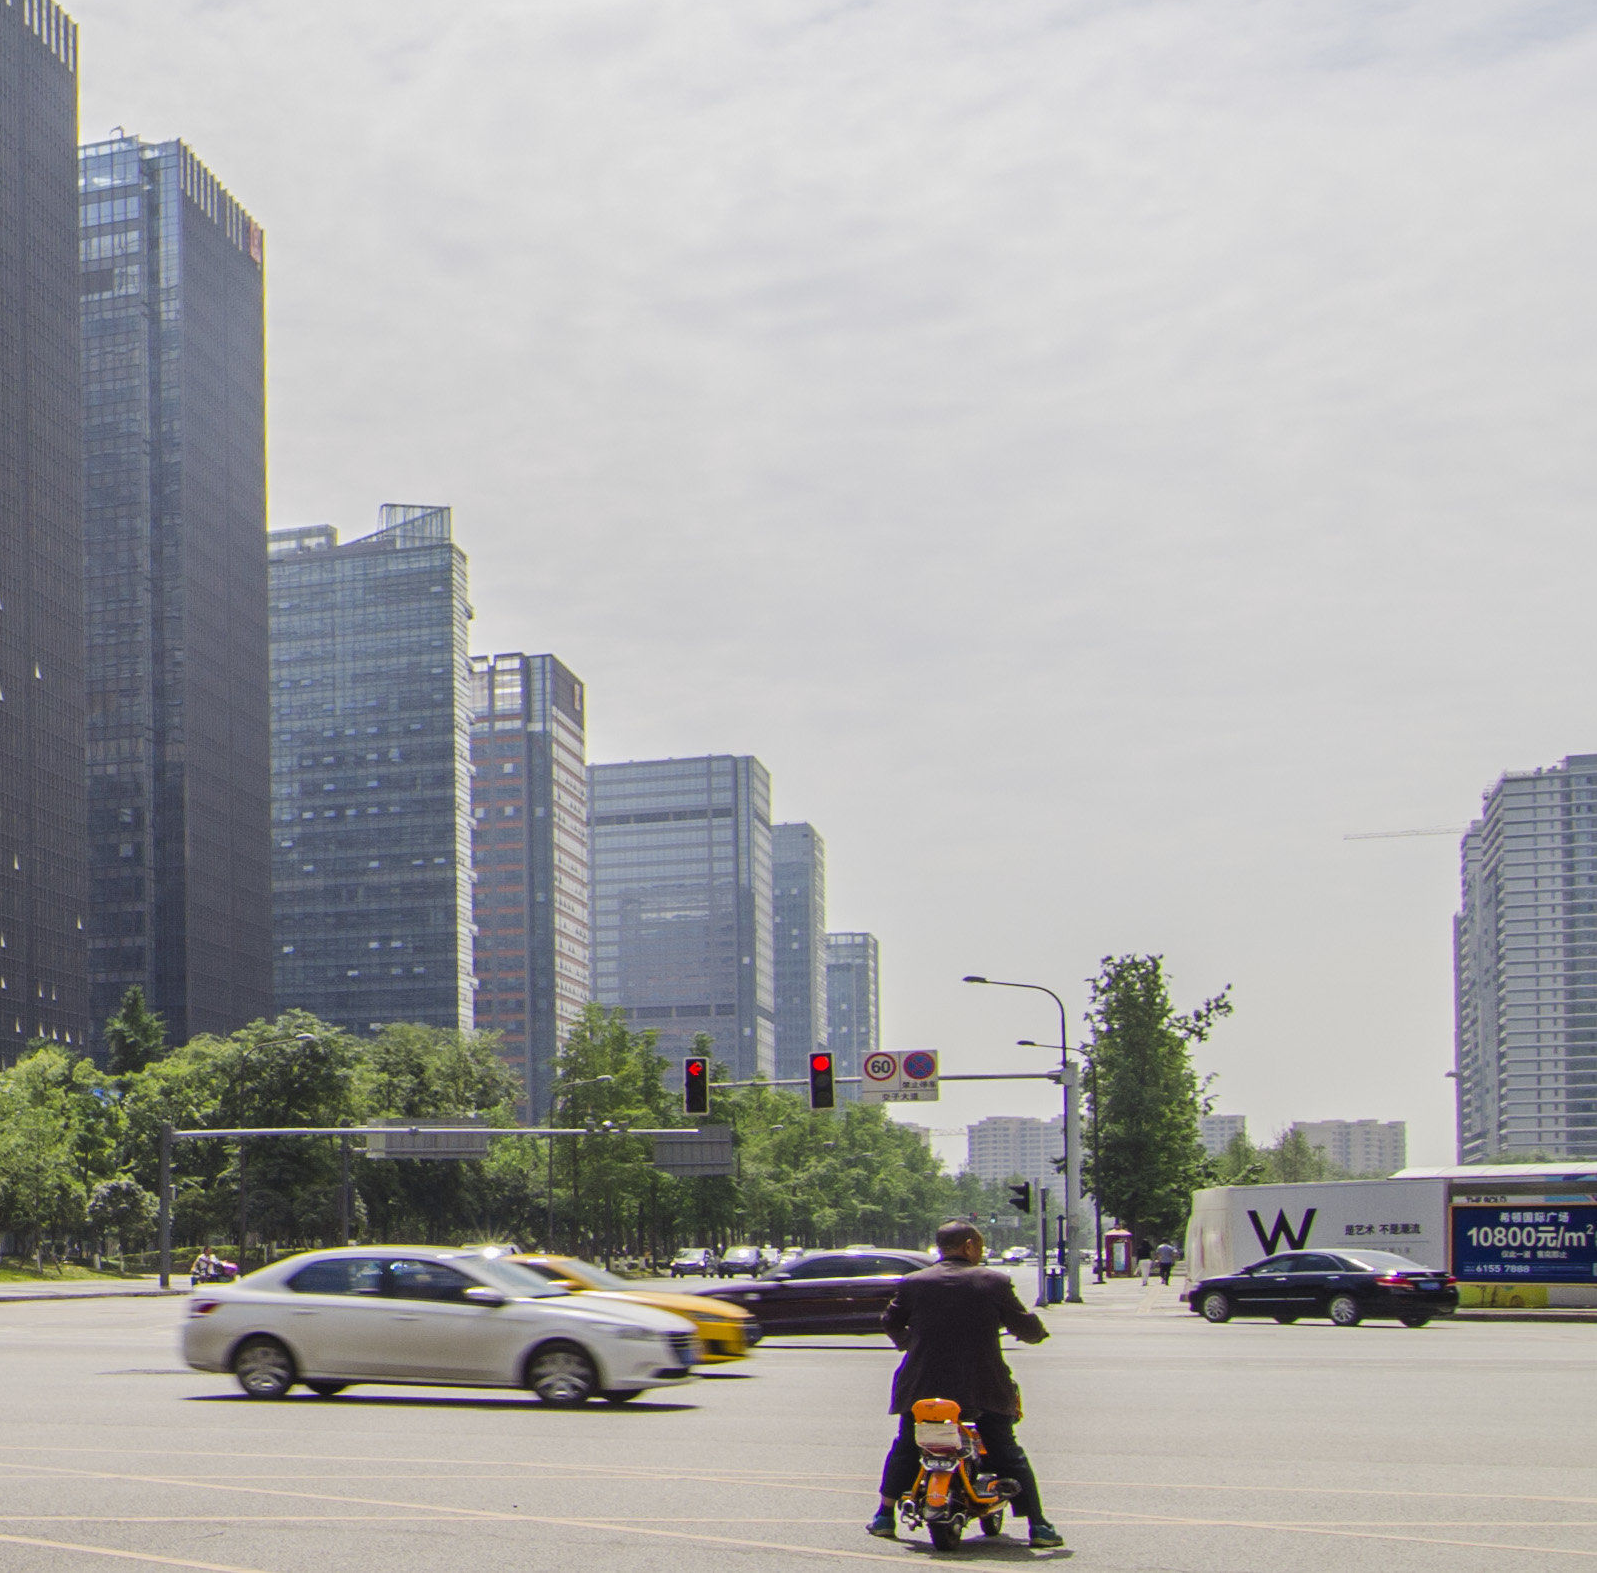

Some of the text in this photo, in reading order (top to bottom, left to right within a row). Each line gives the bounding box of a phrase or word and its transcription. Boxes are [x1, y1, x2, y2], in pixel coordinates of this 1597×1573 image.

[871, 1060, 891, 1074] 60
[1247, 1208, 1318, 1257] W
[1475, 1264, 1502, 1273] 6155
